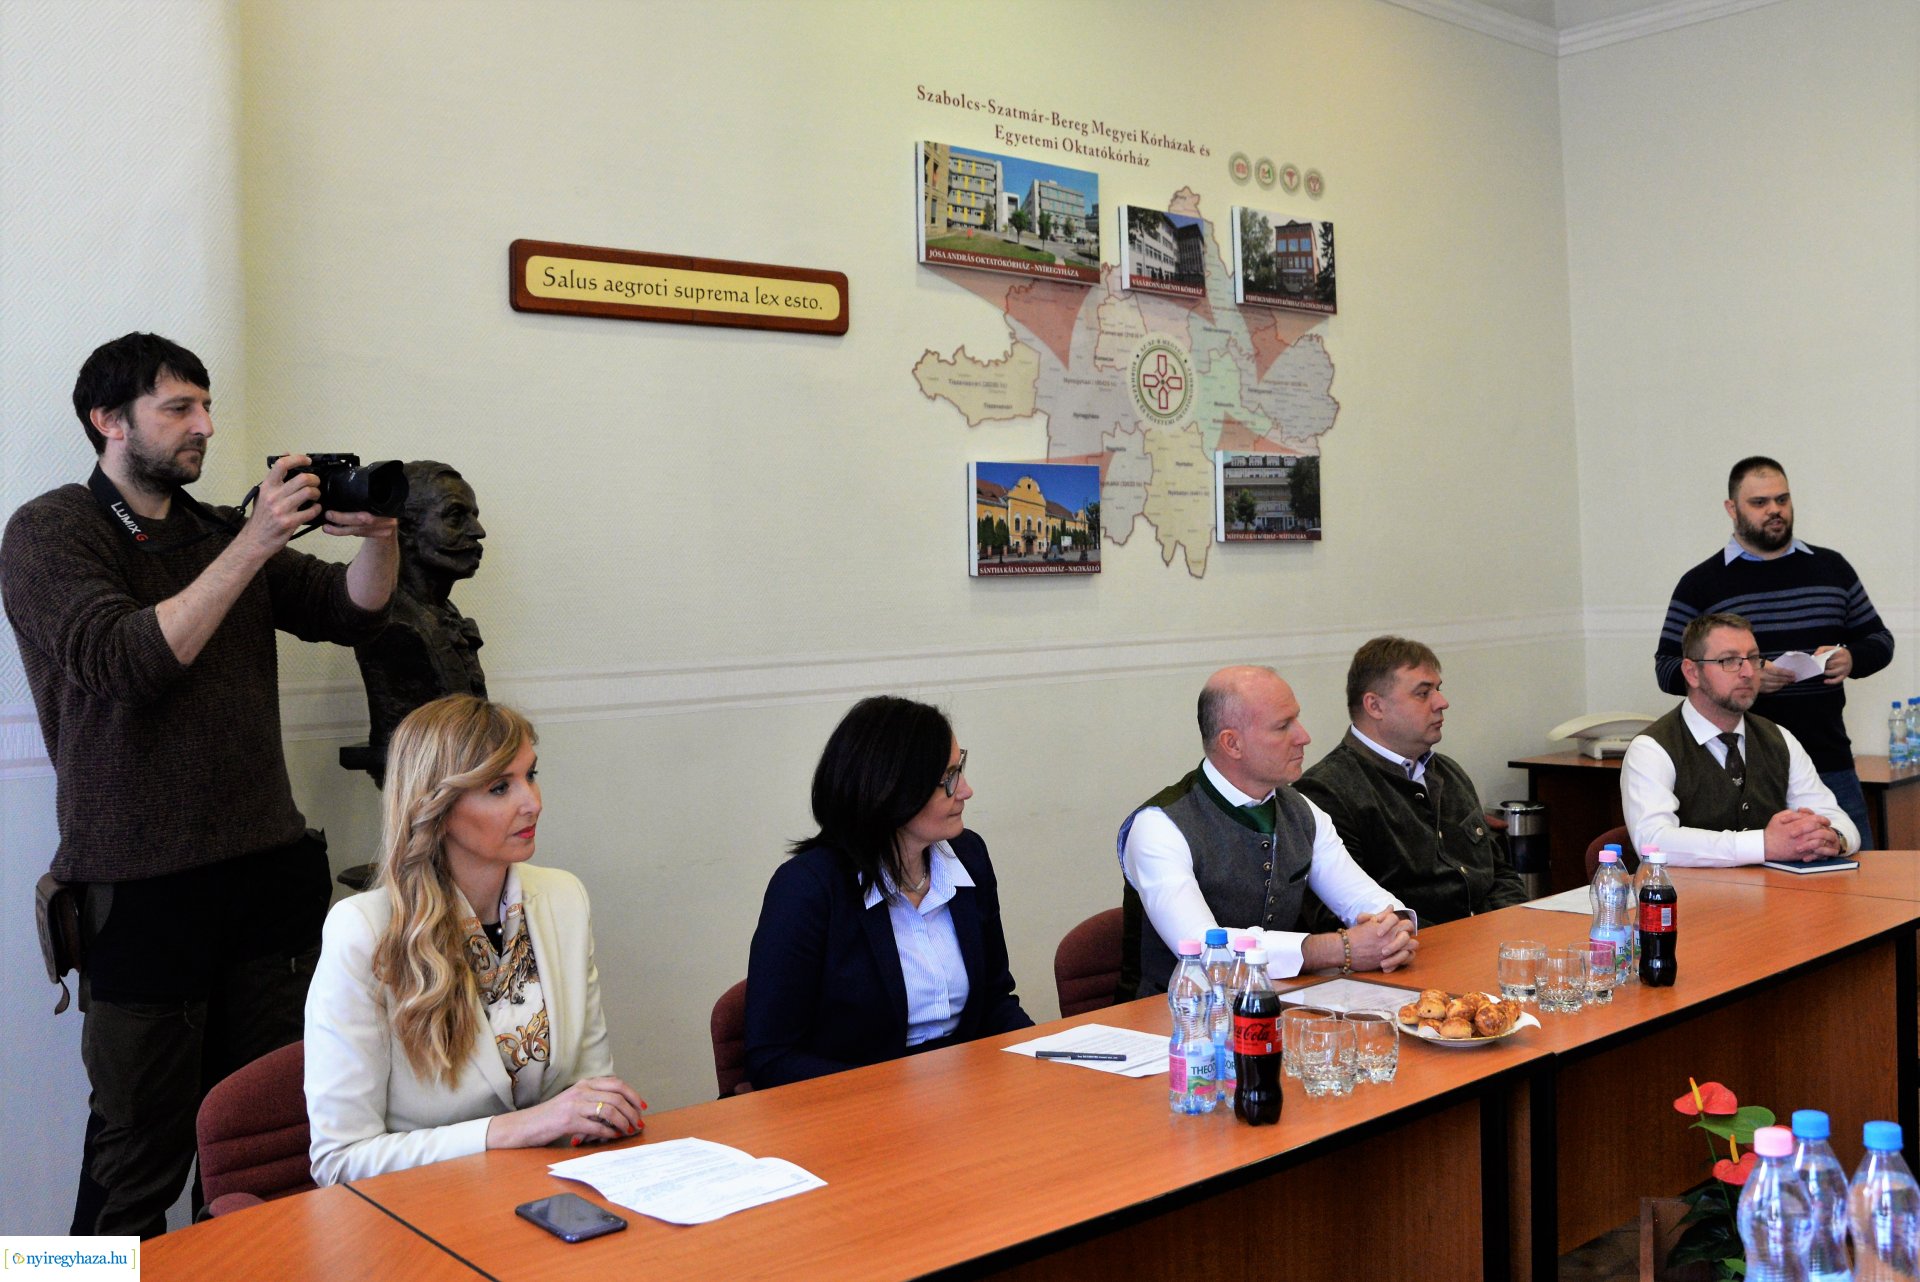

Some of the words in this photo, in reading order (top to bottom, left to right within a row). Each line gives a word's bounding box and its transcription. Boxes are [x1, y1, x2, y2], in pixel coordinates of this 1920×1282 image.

[916, 84, 1089, 136] Szabolcs-Szatmár-Bereg
[1092, 119, 1137, 144] Megyei
[1140, 130, 1196, 154] Kórházak
[1199, 144, 1211, 157] és
[994, 124, 1058, 150] Egyetemi
[1062, 137, 1151, 168] Oktatókórház
[928, 249, 947, 260] JÓSA
[947, 252, 975, 263] ANDRÁS
[542, 266, 598, 291] Salus
[603, 278, 668, 298] aegroti
[674, 283, 750, 304] suprema
[755, 286, 780, 307] lex
[784, 295, 823, 311] esto.
[111, 501, 142, 534] LUMIX
[979, 566, 1004, 574] SÁNTHA
[1004, 565, 1028, 574] KÁLMÁN
